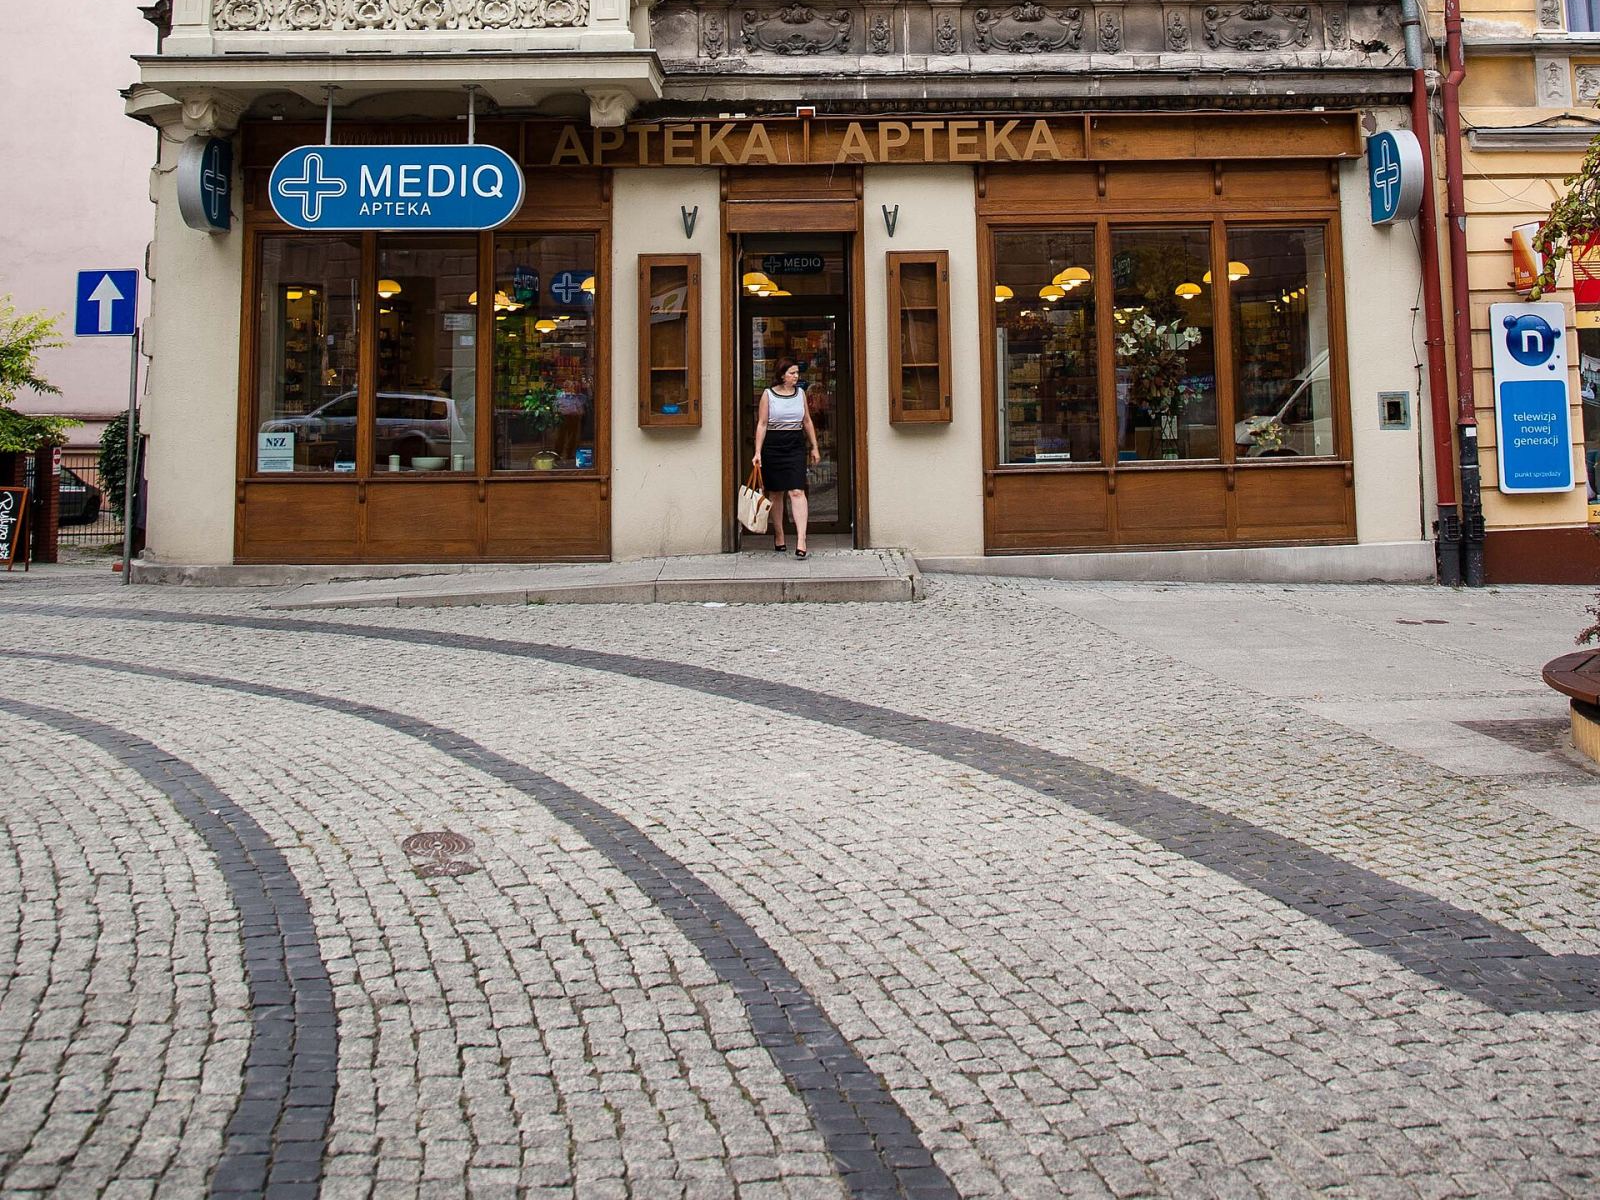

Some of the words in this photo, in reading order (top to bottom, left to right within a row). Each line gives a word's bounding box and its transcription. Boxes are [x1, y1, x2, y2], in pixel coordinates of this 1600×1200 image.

[550, 123, 778, 166] APTEKA
[834, 119, 1064, 163] APTEKA
[359, 164, 504, 198] MEDIQ
[358, 202, 432, 216] APTEKA
[784, 258, 821, 267] MEDIQ
[1521, 330, 1544, 352] n
[1513, 411, 1557, 423] telewizja
[1521, 424, 1551, 434] nowej
[265, 437, 287, 447] NFZ
[1513, 435, 1559, 448] generacji
